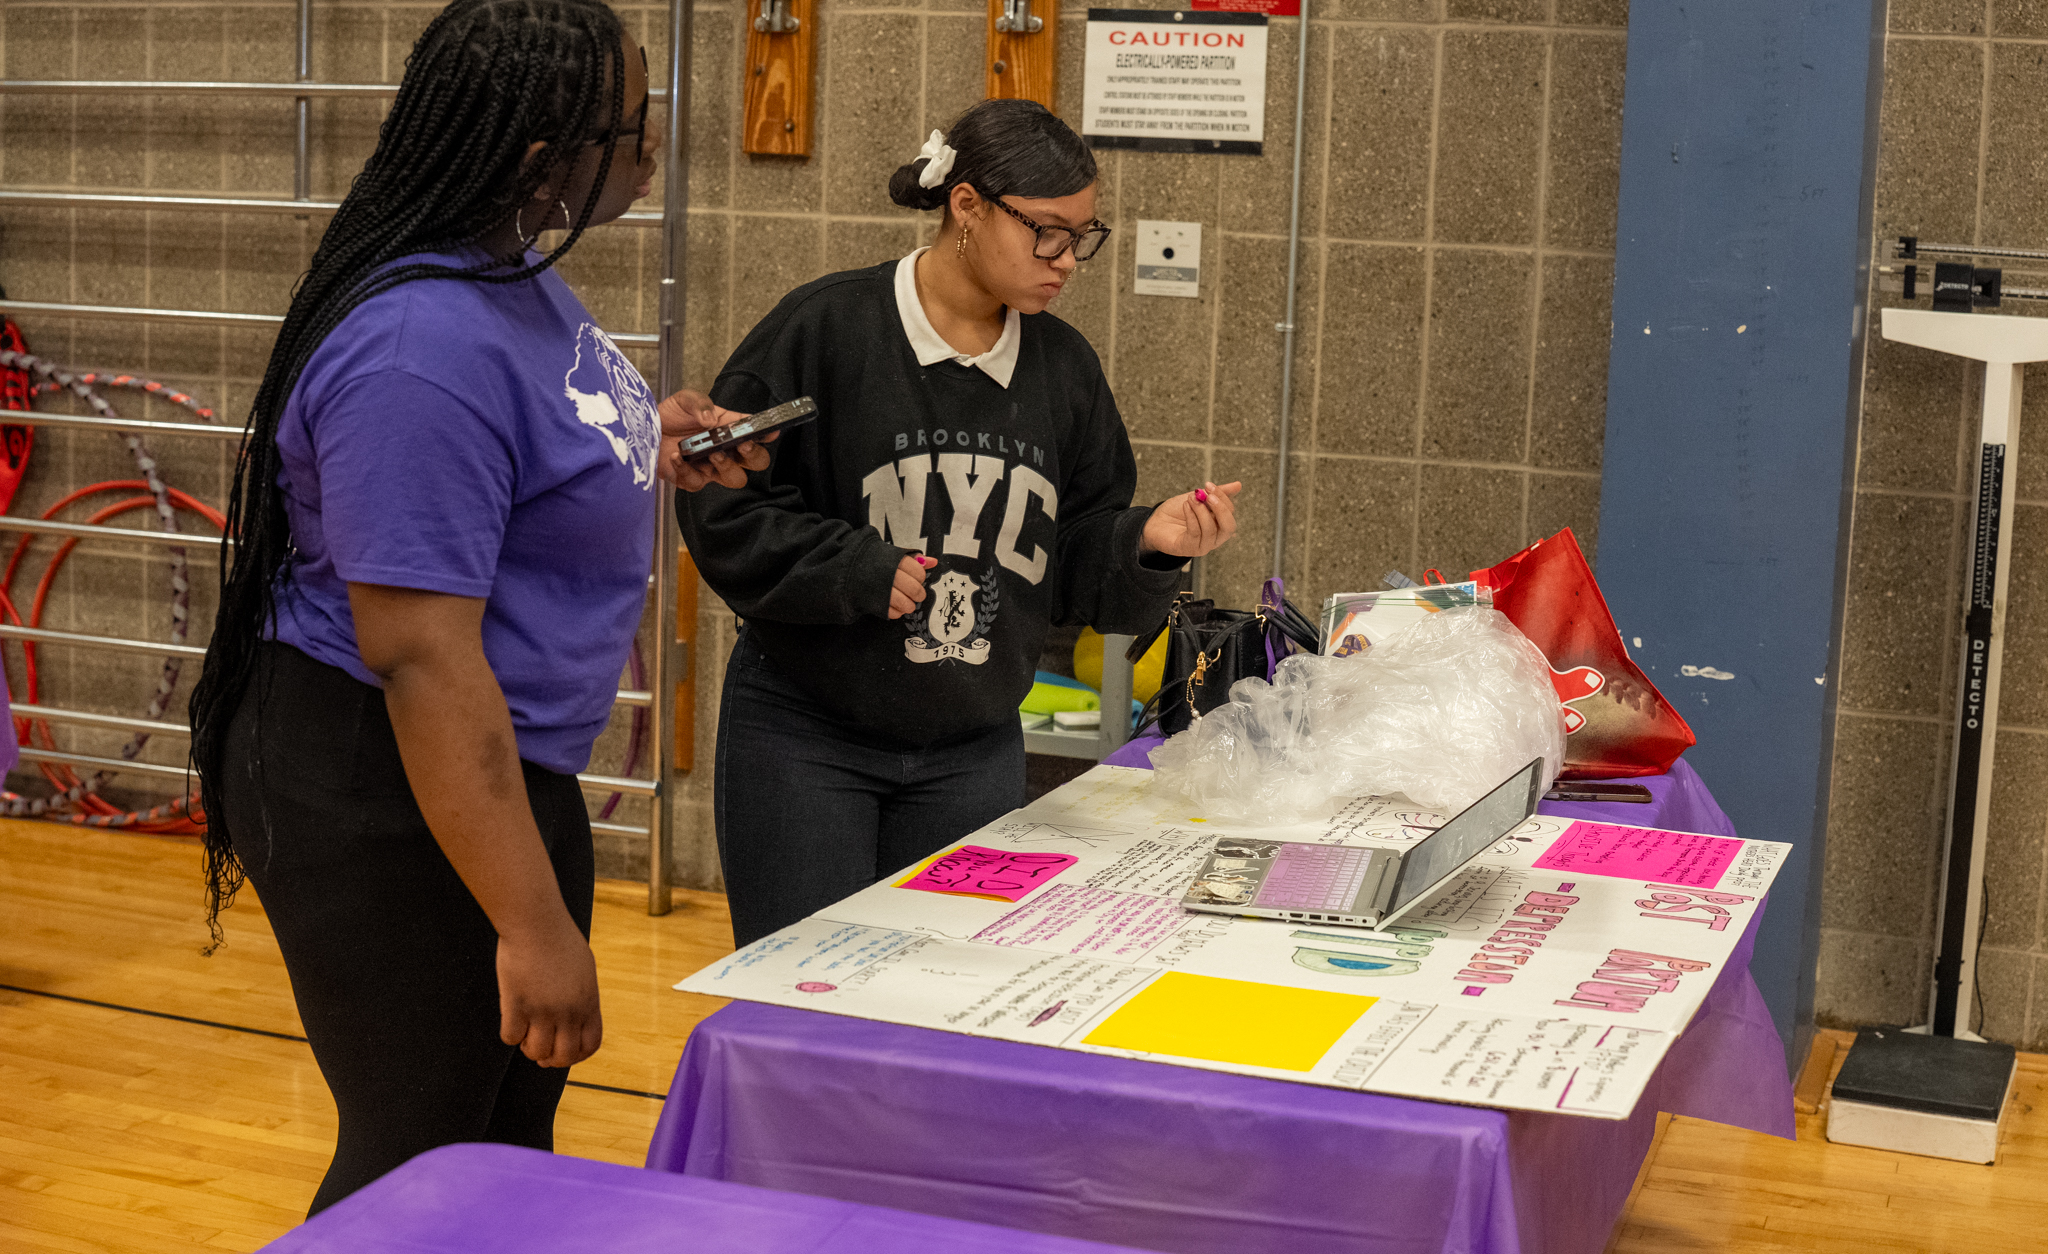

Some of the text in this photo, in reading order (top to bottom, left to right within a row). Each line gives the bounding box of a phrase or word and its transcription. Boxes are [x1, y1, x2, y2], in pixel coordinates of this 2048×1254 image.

[1109, 31, 1244, 47] CAUTION
[1116, 53, 1236, 70] ELECTRICALLY-POWERED PARTITION
[1095, 120, 1120, 129] STUDENTS
[1121, 120, 1134, 129] MUST
[1184, 122, 1208, 131] PARTITION
[1232, 123, 1250, 132] MOTION
[895, 429, 1044, 467] BROOKLYN
[863, 453, 1058, 586] NYC
[934, 645, 965, 659] 1975
[1966, 639, 1985, 730] DETECTO
[899, 847, 1004, 885] Know?
[956, 852, 1076, 893] DID
[1493, 868, 1535, 890] WHAT
[1480, 889, 1518, 903] IS
[1634, 883, 1755, 932] POST
[1289, 925, 1449, 977] PPD
[1453, 890, 1580, 985] DEPRESSION
